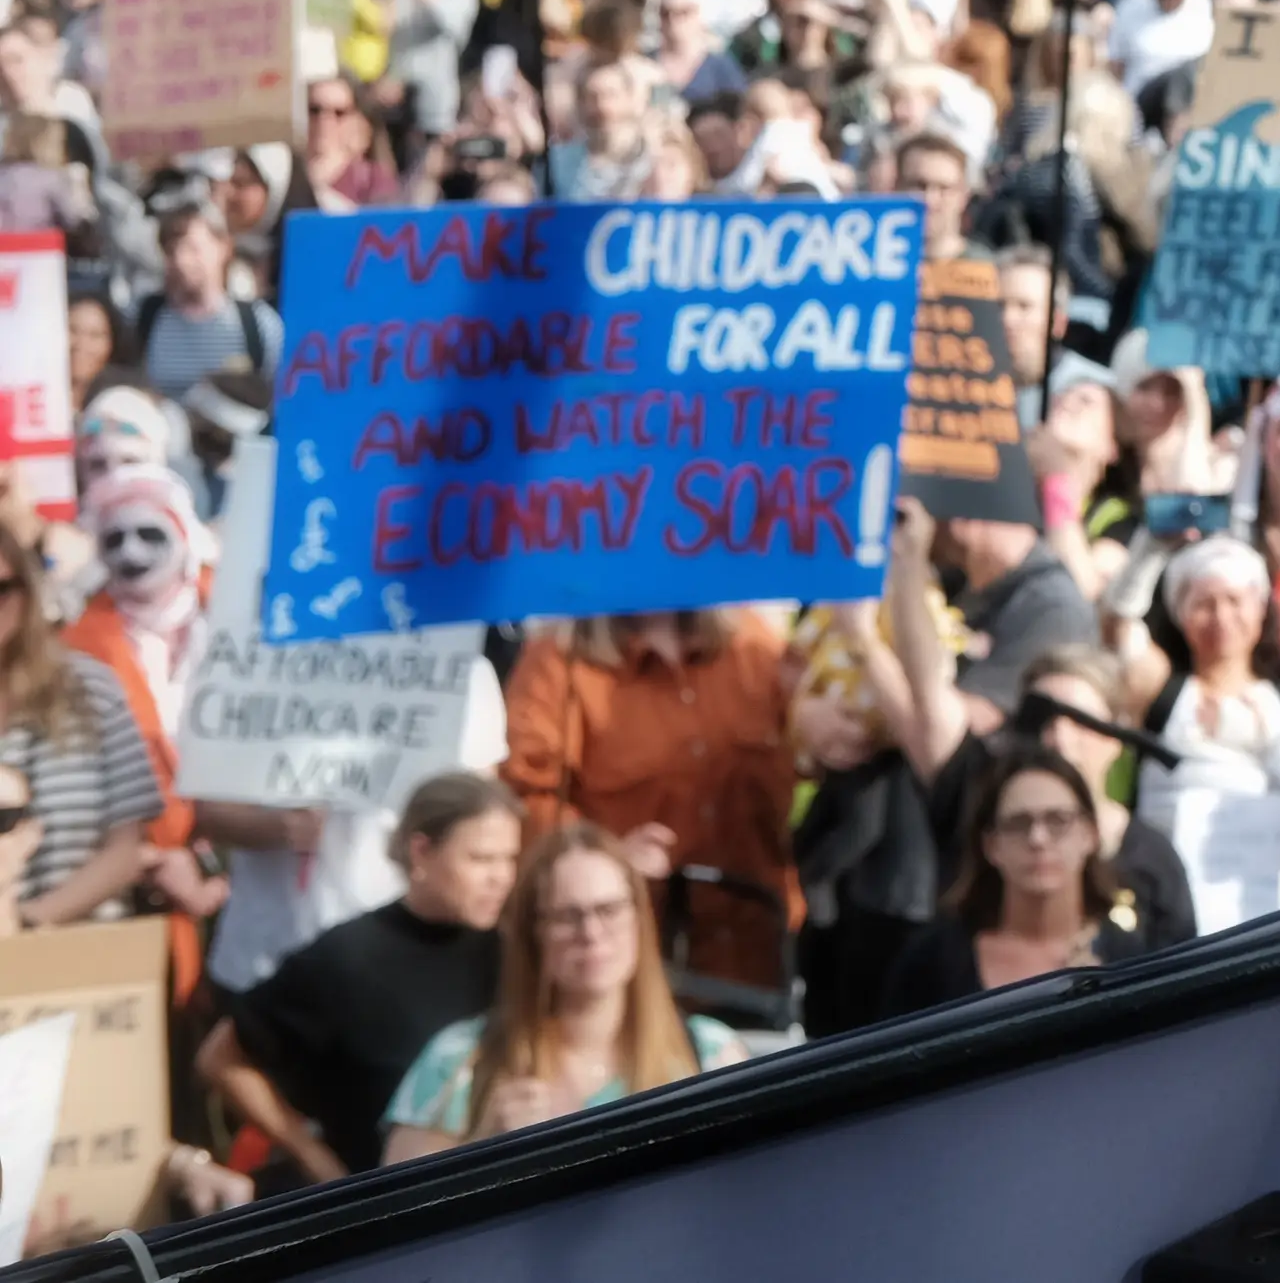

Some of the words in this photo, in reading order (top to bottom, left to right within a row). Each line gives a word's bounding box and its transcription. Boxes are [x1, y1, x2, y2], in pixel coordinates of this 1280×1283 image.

[1221, 11, 1273, 59] I
[344, 208, 555, 290] MAKE
[584, 208, 916, 297] CHILDCARE
[283, 311, 641, 398] AFFORDABLE
[667, 302, 775, 376] FOR
[773, 299, 907, 372] ALL
[352, 405, 492, 472] AND
[514, 390, 705, 454] WATCH
[725, 387, 839, 449] THE
[371, 465, 653, 574] ECONOMY
[190, 684, 438, 748] CHILDCARE
